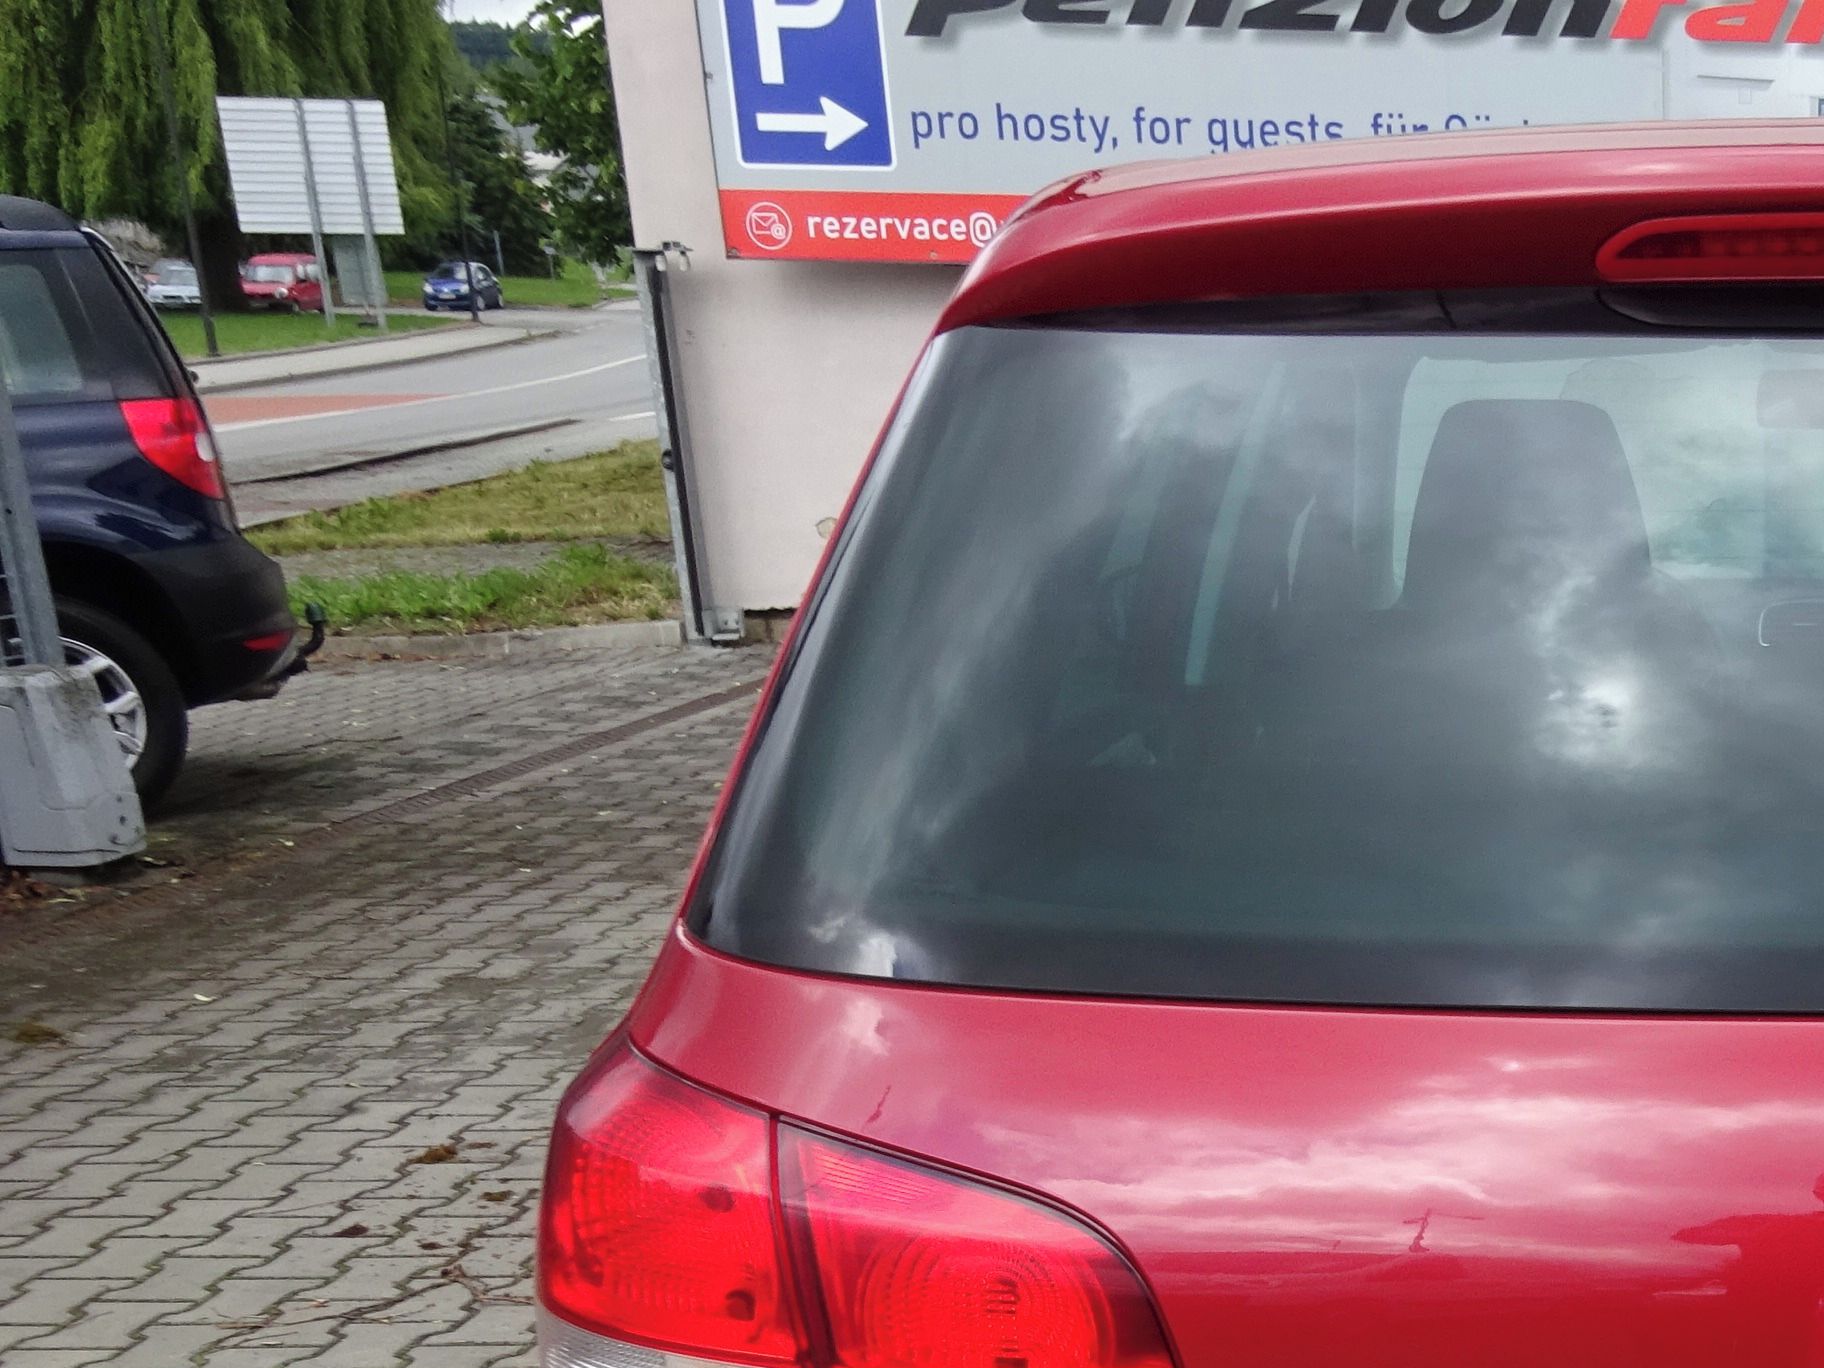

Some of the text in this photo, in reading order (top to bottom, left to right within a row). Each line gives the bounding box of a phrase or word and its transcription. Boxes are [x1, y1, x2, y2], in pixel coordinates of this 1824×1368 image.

[752, 0, 845, 84] P
[910, 109, 979, 149] pro
[995, 102, 1118, 153] hosty,
[1133, 106, 1192, 145] for
[807, 211, 1003, 248] rezervace@
